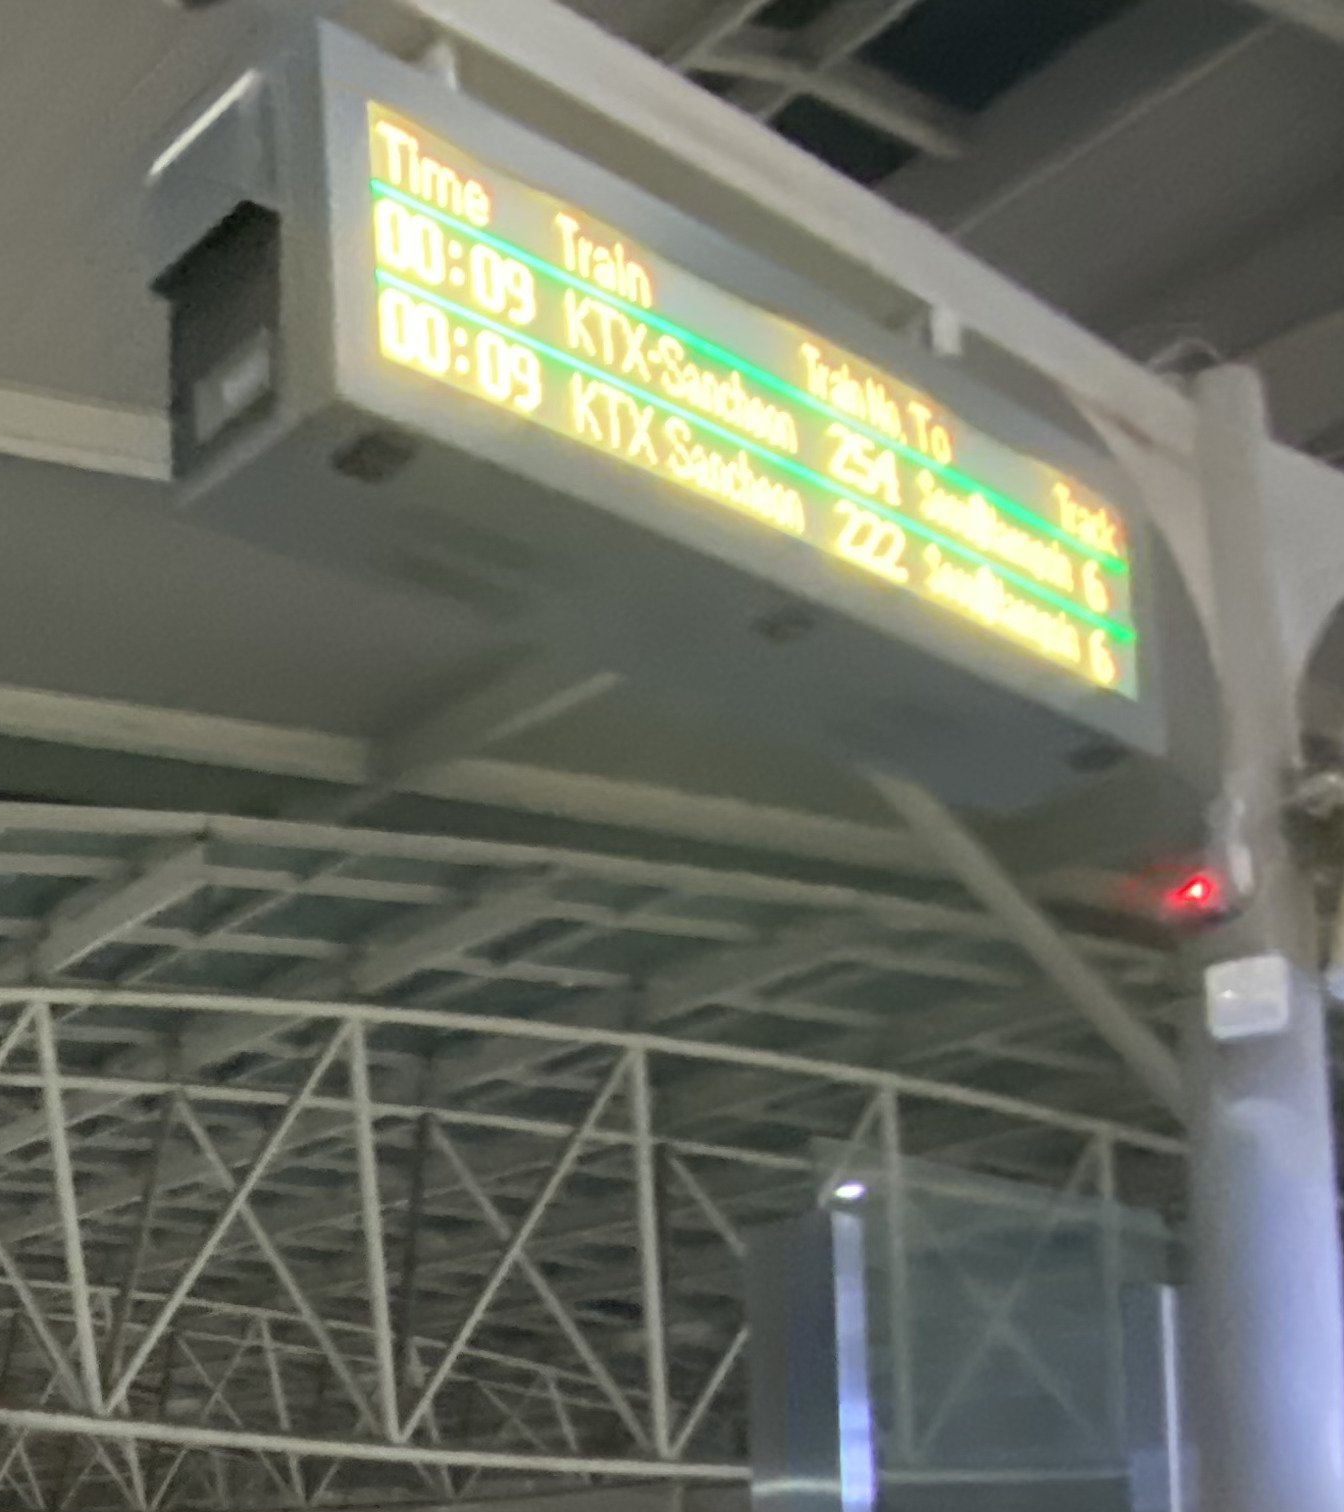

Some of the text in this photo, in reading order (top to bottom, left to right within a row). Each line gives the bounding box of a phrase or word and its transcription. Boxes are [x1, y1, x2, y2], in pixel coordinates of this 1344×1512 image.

[374, 198, 535, 325] 00:09
[1082, 560, 1107, 612] 6
[376, 120, 490, 226] Time
[555, 213, 652, 308] Train
[908, 401, 951, 464] To
[378, 287, 541, 411] 00:09
[833, 499, 908, 583] 222
[1090, 629, 1114, 684] 6
